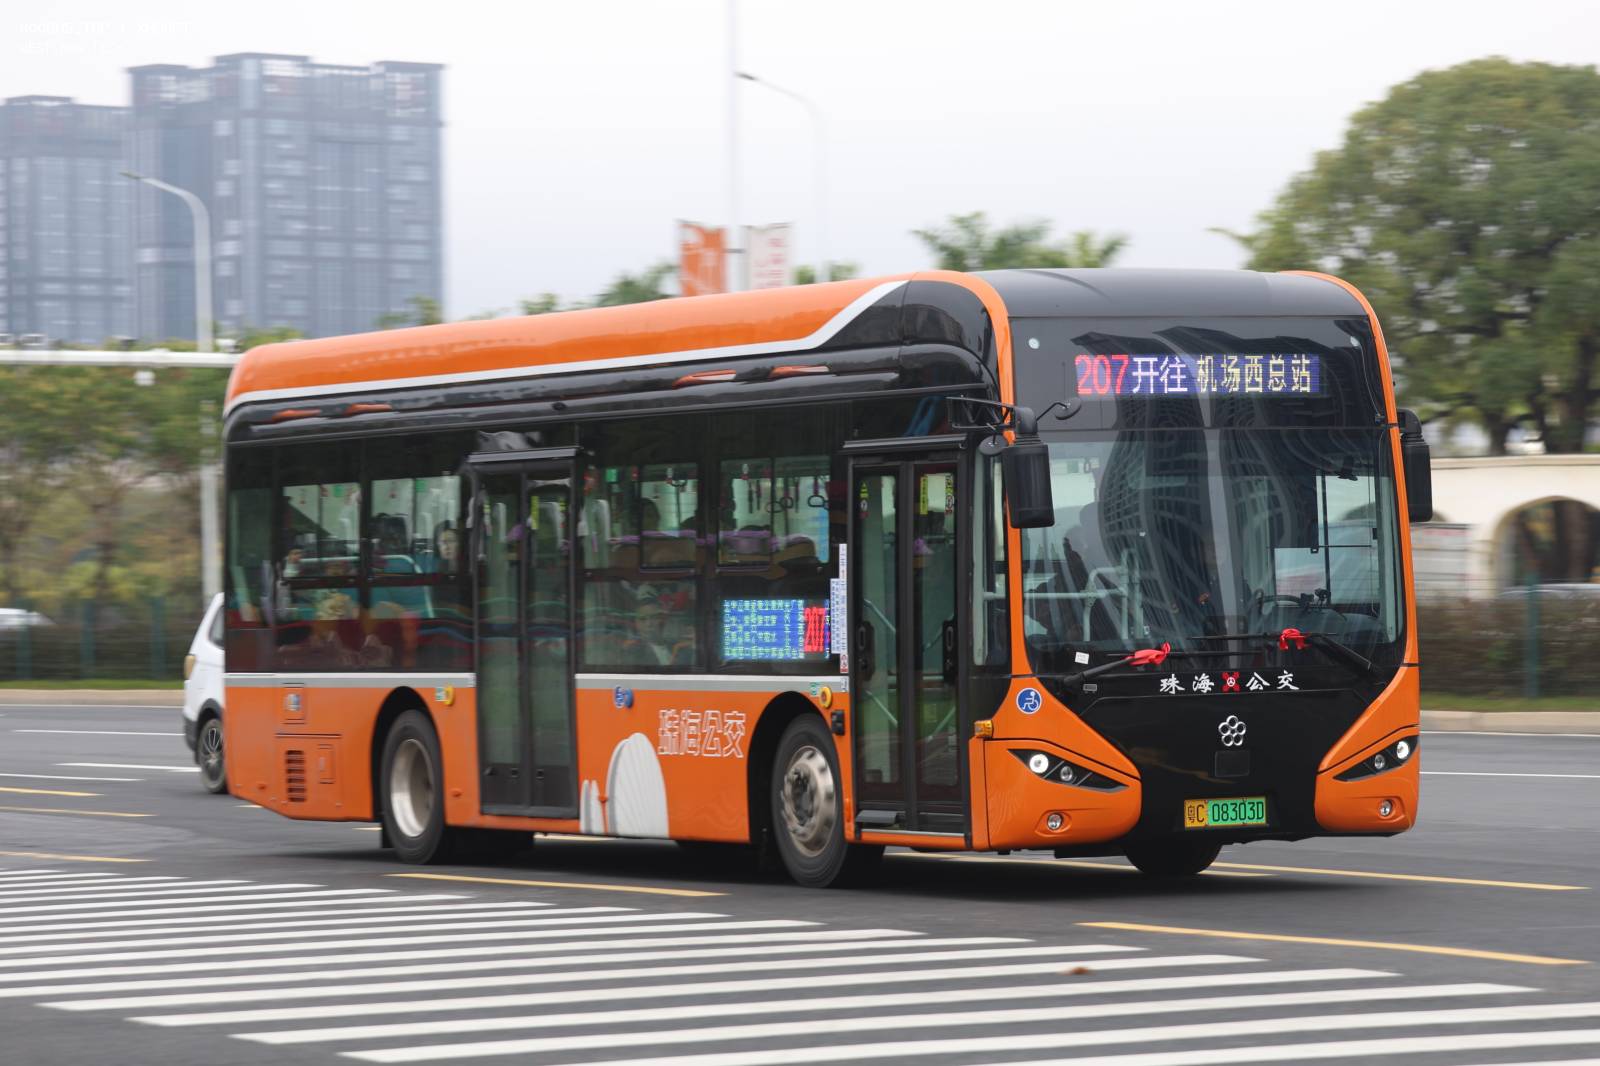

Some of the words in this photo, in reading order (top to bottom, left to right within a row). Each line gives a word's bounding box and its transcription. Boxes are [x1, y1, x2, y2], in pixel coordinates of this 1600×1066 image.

[1074, 354, 1130, 395] 207
[1132, 356, 1189, 394] 开往
[1197, 354, 1311, 393] 机场西总站
[1159, 672, 1215, 695] 珠海
[1245, 669, 1300, 691] 公交
[1211, 801, 1265, 822] 08303D
